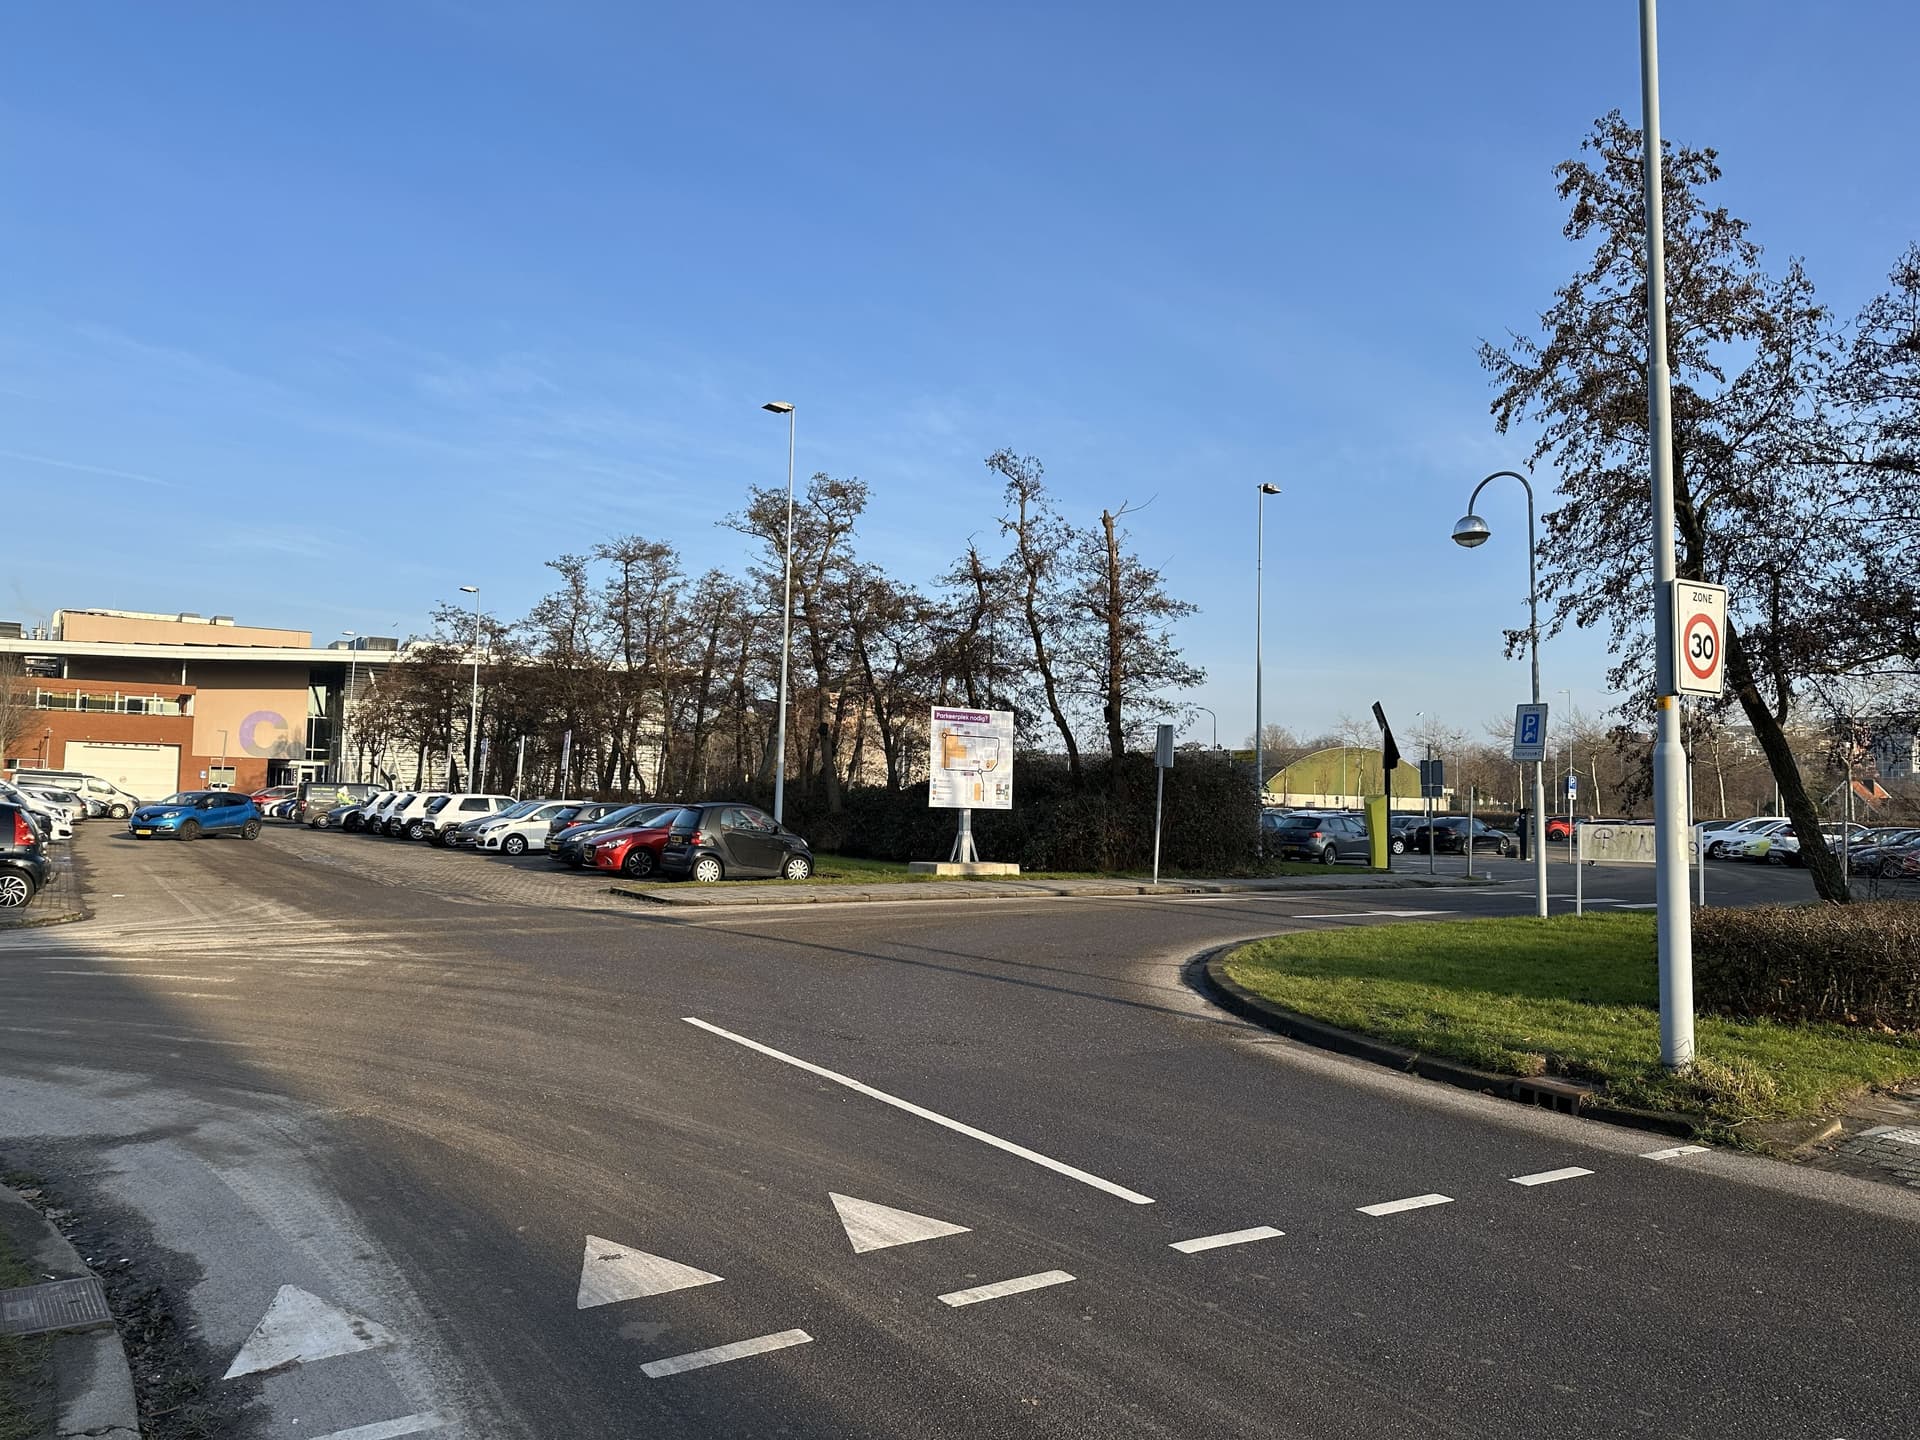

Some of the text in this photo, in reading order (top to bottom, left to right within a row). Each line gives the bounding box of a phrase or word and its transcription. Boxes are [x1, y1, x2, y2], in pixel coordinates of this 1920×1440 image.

[1692, 592, 1713, 604] ZONE
[1691, 633, 1714, 660] 30
[936, 712, 989, 722] Parkeerplek nodig?
[1525, 715, 1536, 731] P
